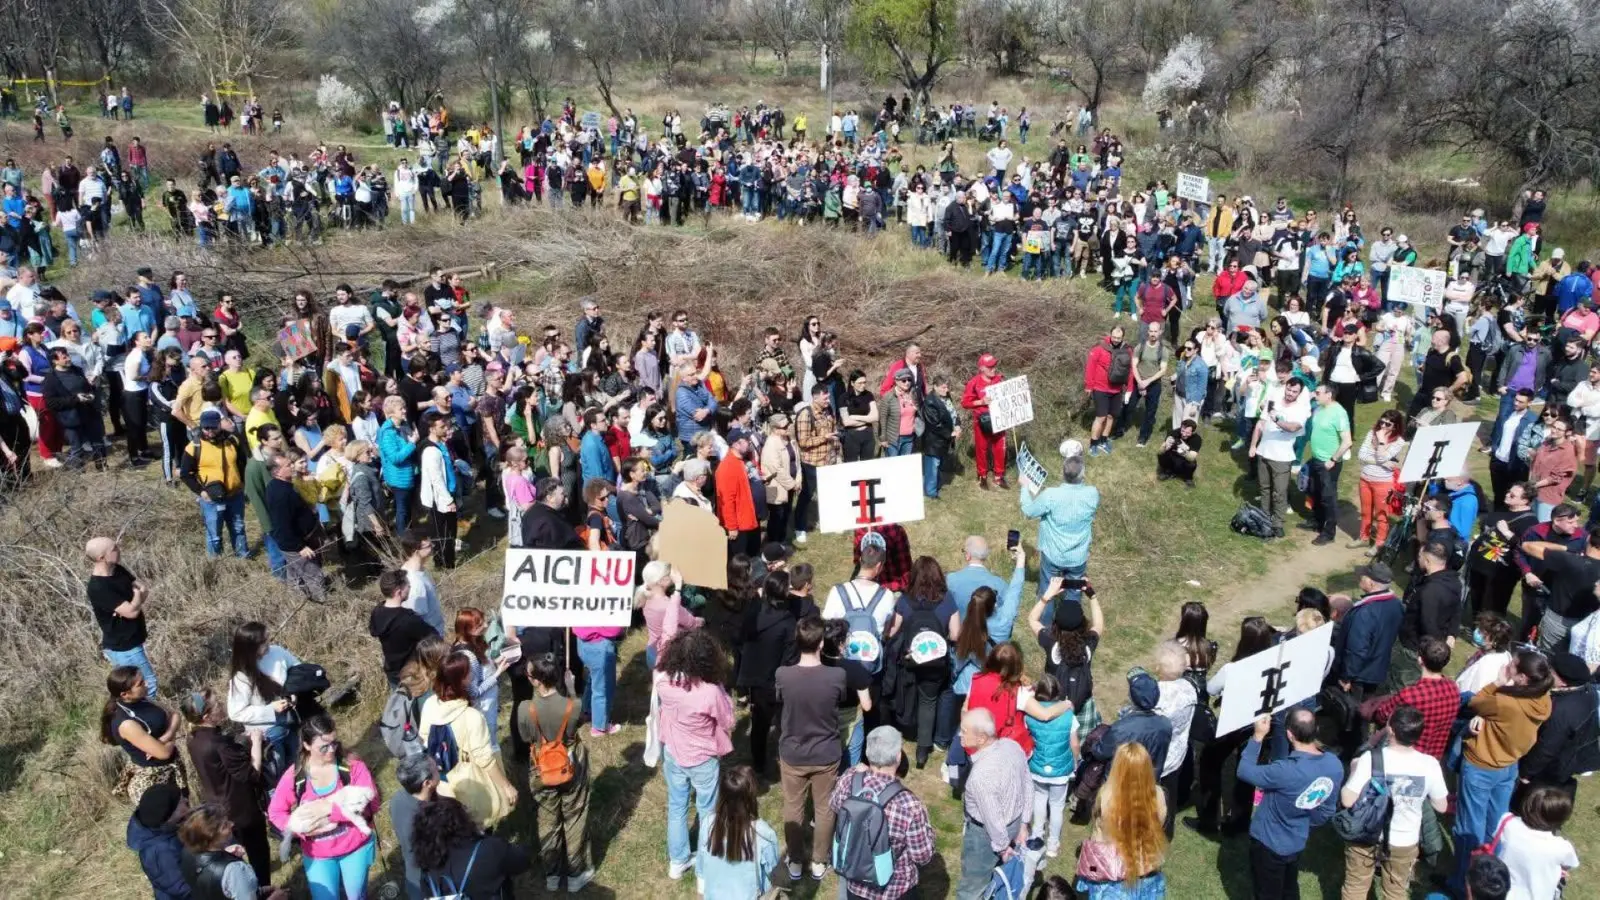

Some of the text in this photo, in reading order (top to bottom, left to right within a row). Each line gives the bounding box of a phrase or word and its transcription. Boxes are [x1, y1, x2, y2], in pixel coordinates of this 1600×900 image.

[1422, 276, 1433, 305] STOP
[1010, 391, 1028, 408] RON
[994, 406, 1032, 430] COPACUL
[512, 554, 633, 586] AICI NU
[503, 594, 631, 616] CONSTRUIȚI!
